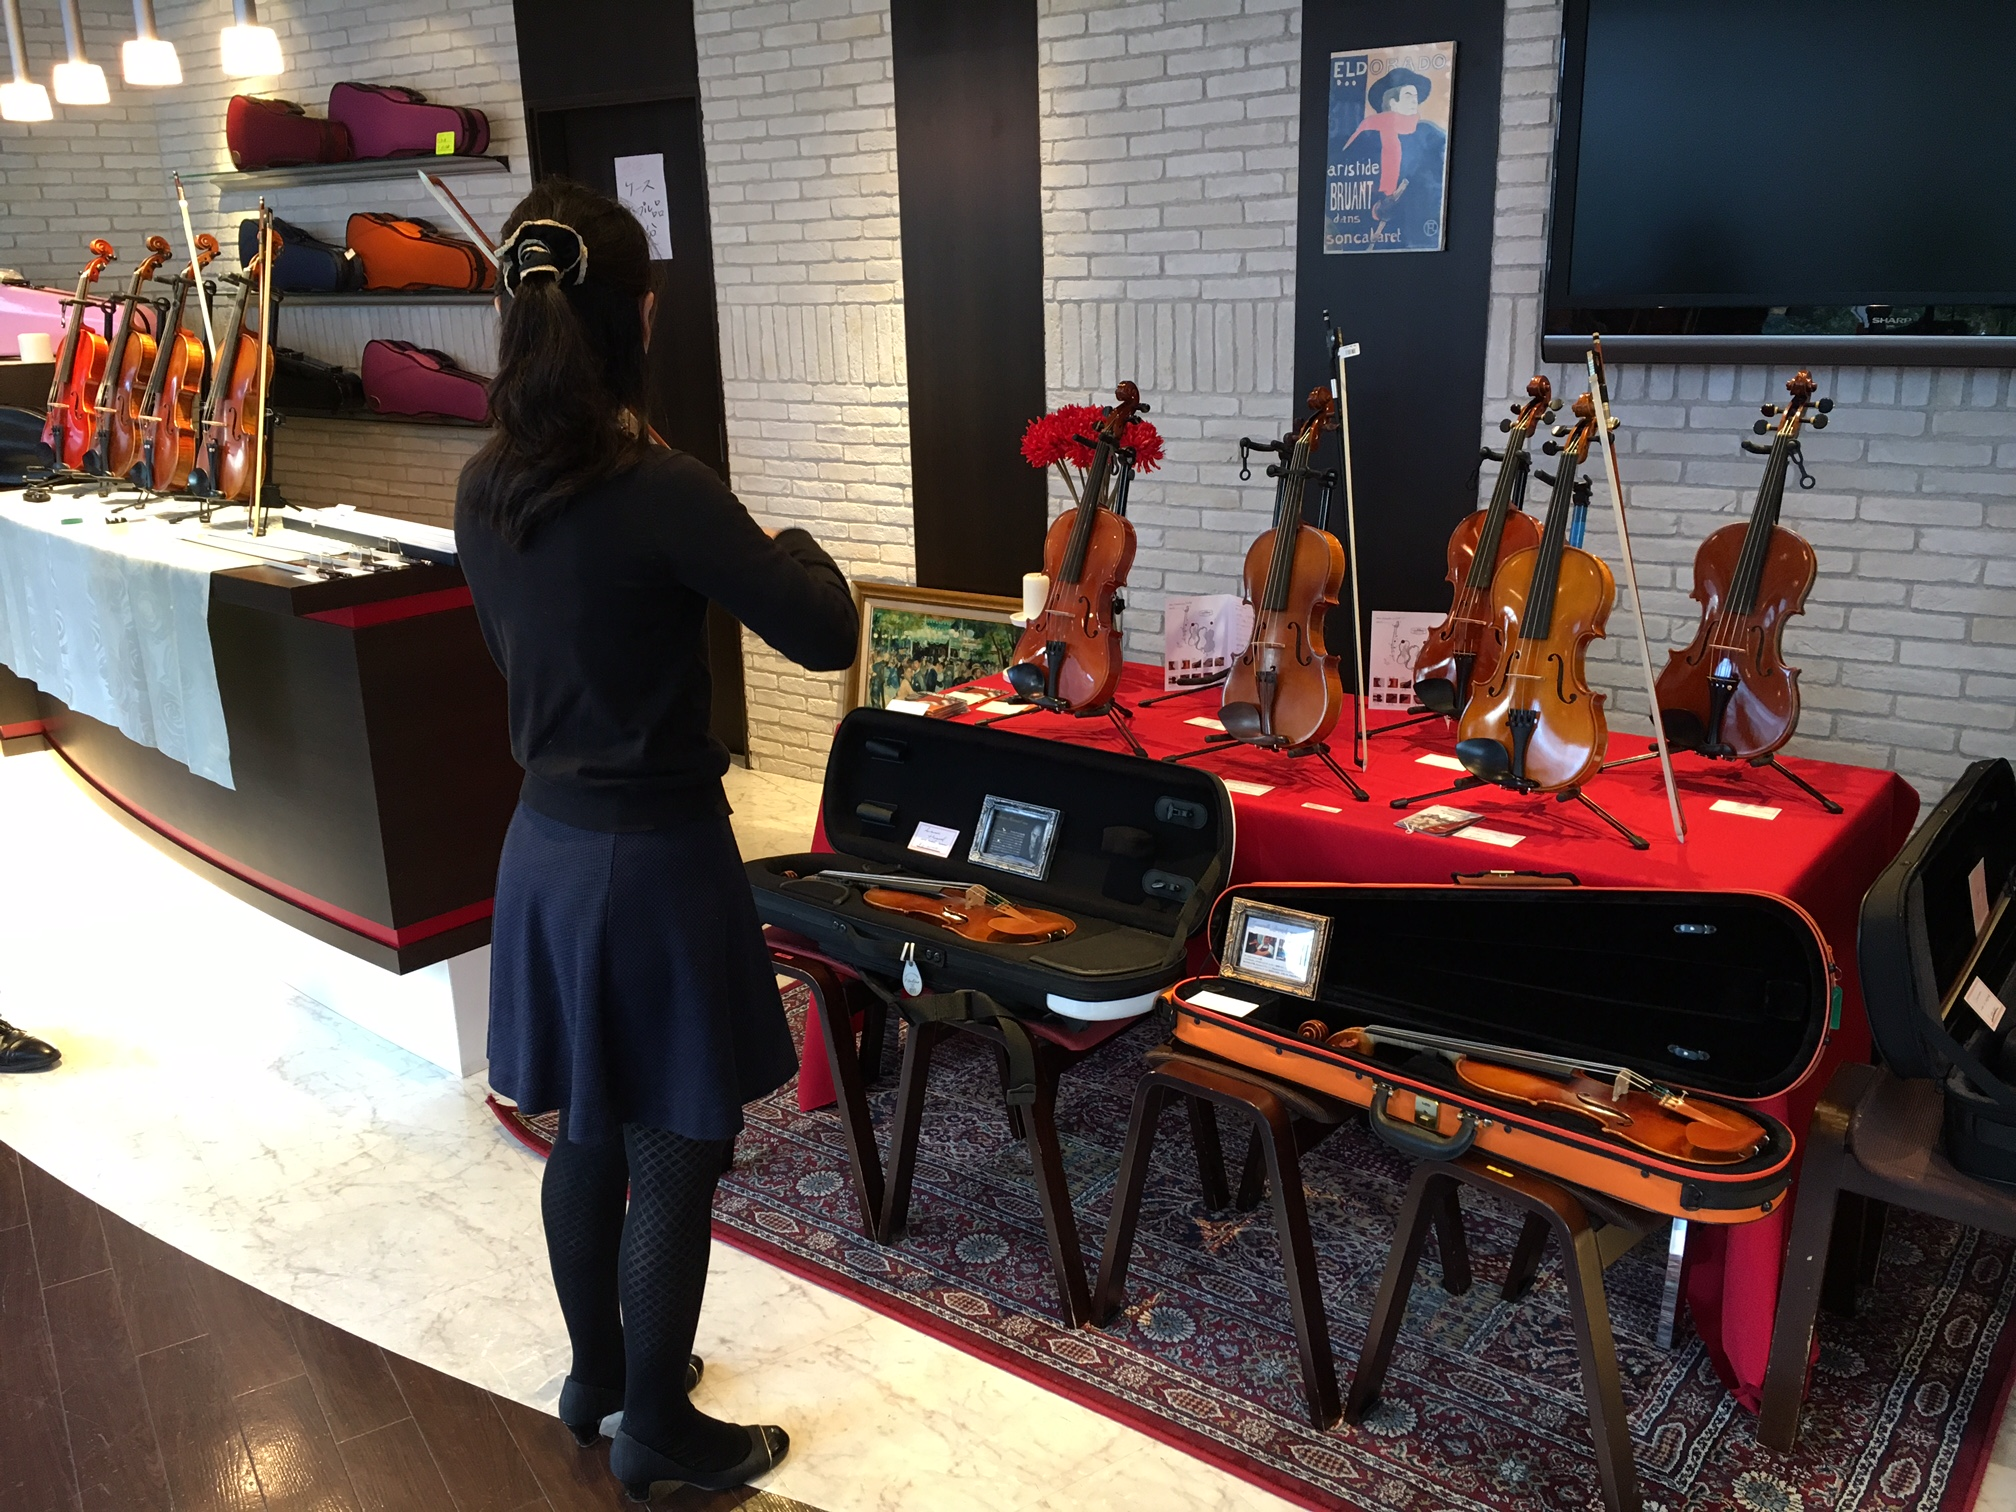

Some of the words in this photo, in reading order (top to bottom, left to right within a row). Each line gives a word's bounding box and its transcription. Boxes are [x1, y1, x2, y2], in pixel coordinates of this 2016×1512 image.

[1333, 53, 1447, 78] ELDORADO
[1327, 158, 1380, 177] aristide
[1330, 180, 1374, 211] BRUANT
[1333, 213, 1361, 224] dans
